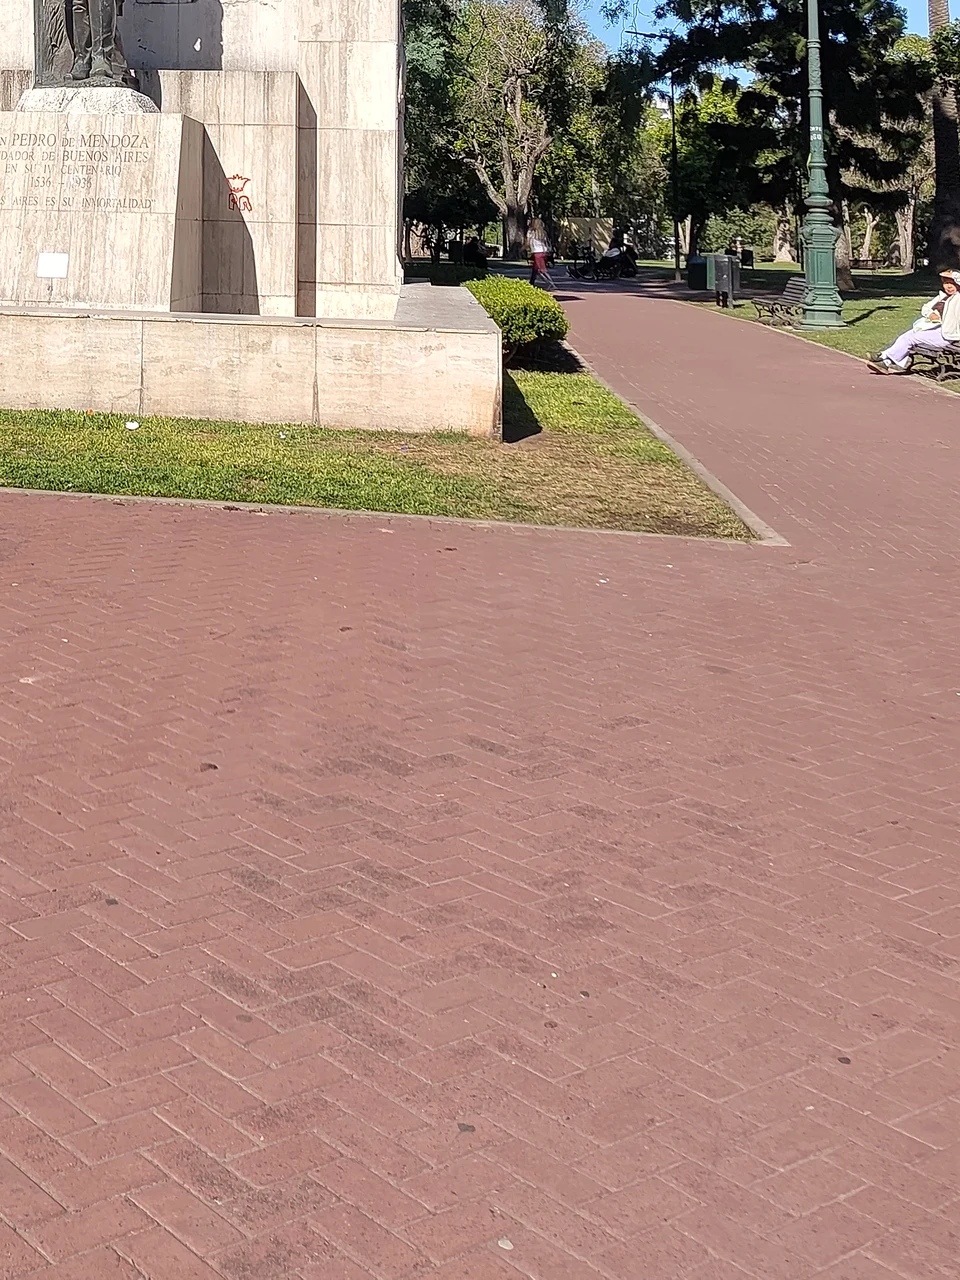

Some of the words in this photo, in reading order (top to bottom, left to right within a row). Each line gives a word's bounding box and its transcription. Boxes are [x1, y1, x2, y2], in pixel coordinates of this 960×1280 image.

[62, 122, 70, 132] A
[11, 133, 57, 147] PEDRO
[79, 134, 149, 149] MENDOZA
[41, 151, 56, 161] DE
[62, 150, 108, 162] BUENOS
[114, 151, 149, 163] AIRES
[5, 163, 18, 174] EN
[30, 176, 52, 188] 1536
[12, 196, 39, 207] AIRES
[45, 196, 56, 207] ES
[62, 196, 74, 207] SU
